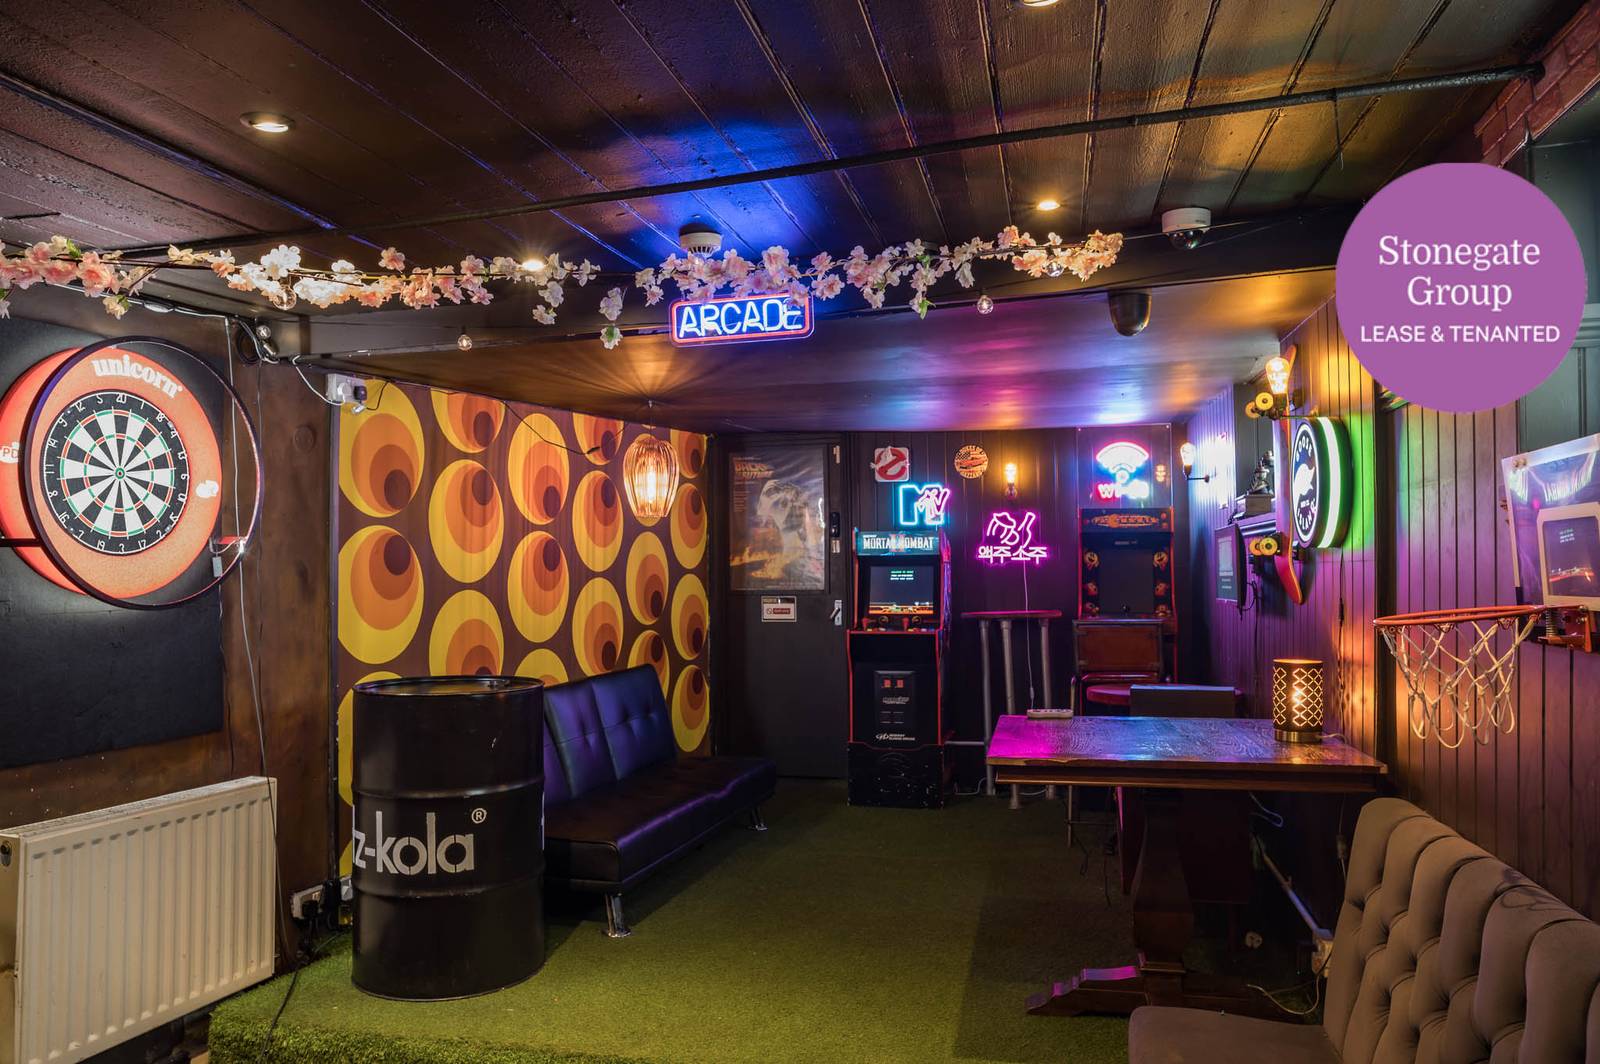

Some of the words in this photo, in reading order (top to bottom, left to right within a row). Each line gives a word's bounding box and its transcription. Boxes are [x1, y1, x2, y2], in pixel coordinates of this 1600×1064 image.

[679, 299, 803, 338] ARCADE
[91, 355, 179, 399] unicorn
[96, 395, 103, 404] 5
[116, 394, 127, 404] 20
[74, 401, 86, 412] 12
[156, 413, 166, 422] 18
[47, 438, 59, 449] 14
[58, 512, 70, 526] 16
[97, 540, 106, 551] 19
[118, 543, 125, 553] 3
[138, 539, 147, 550] 17
[352, 806, 474, 876] z-kola
